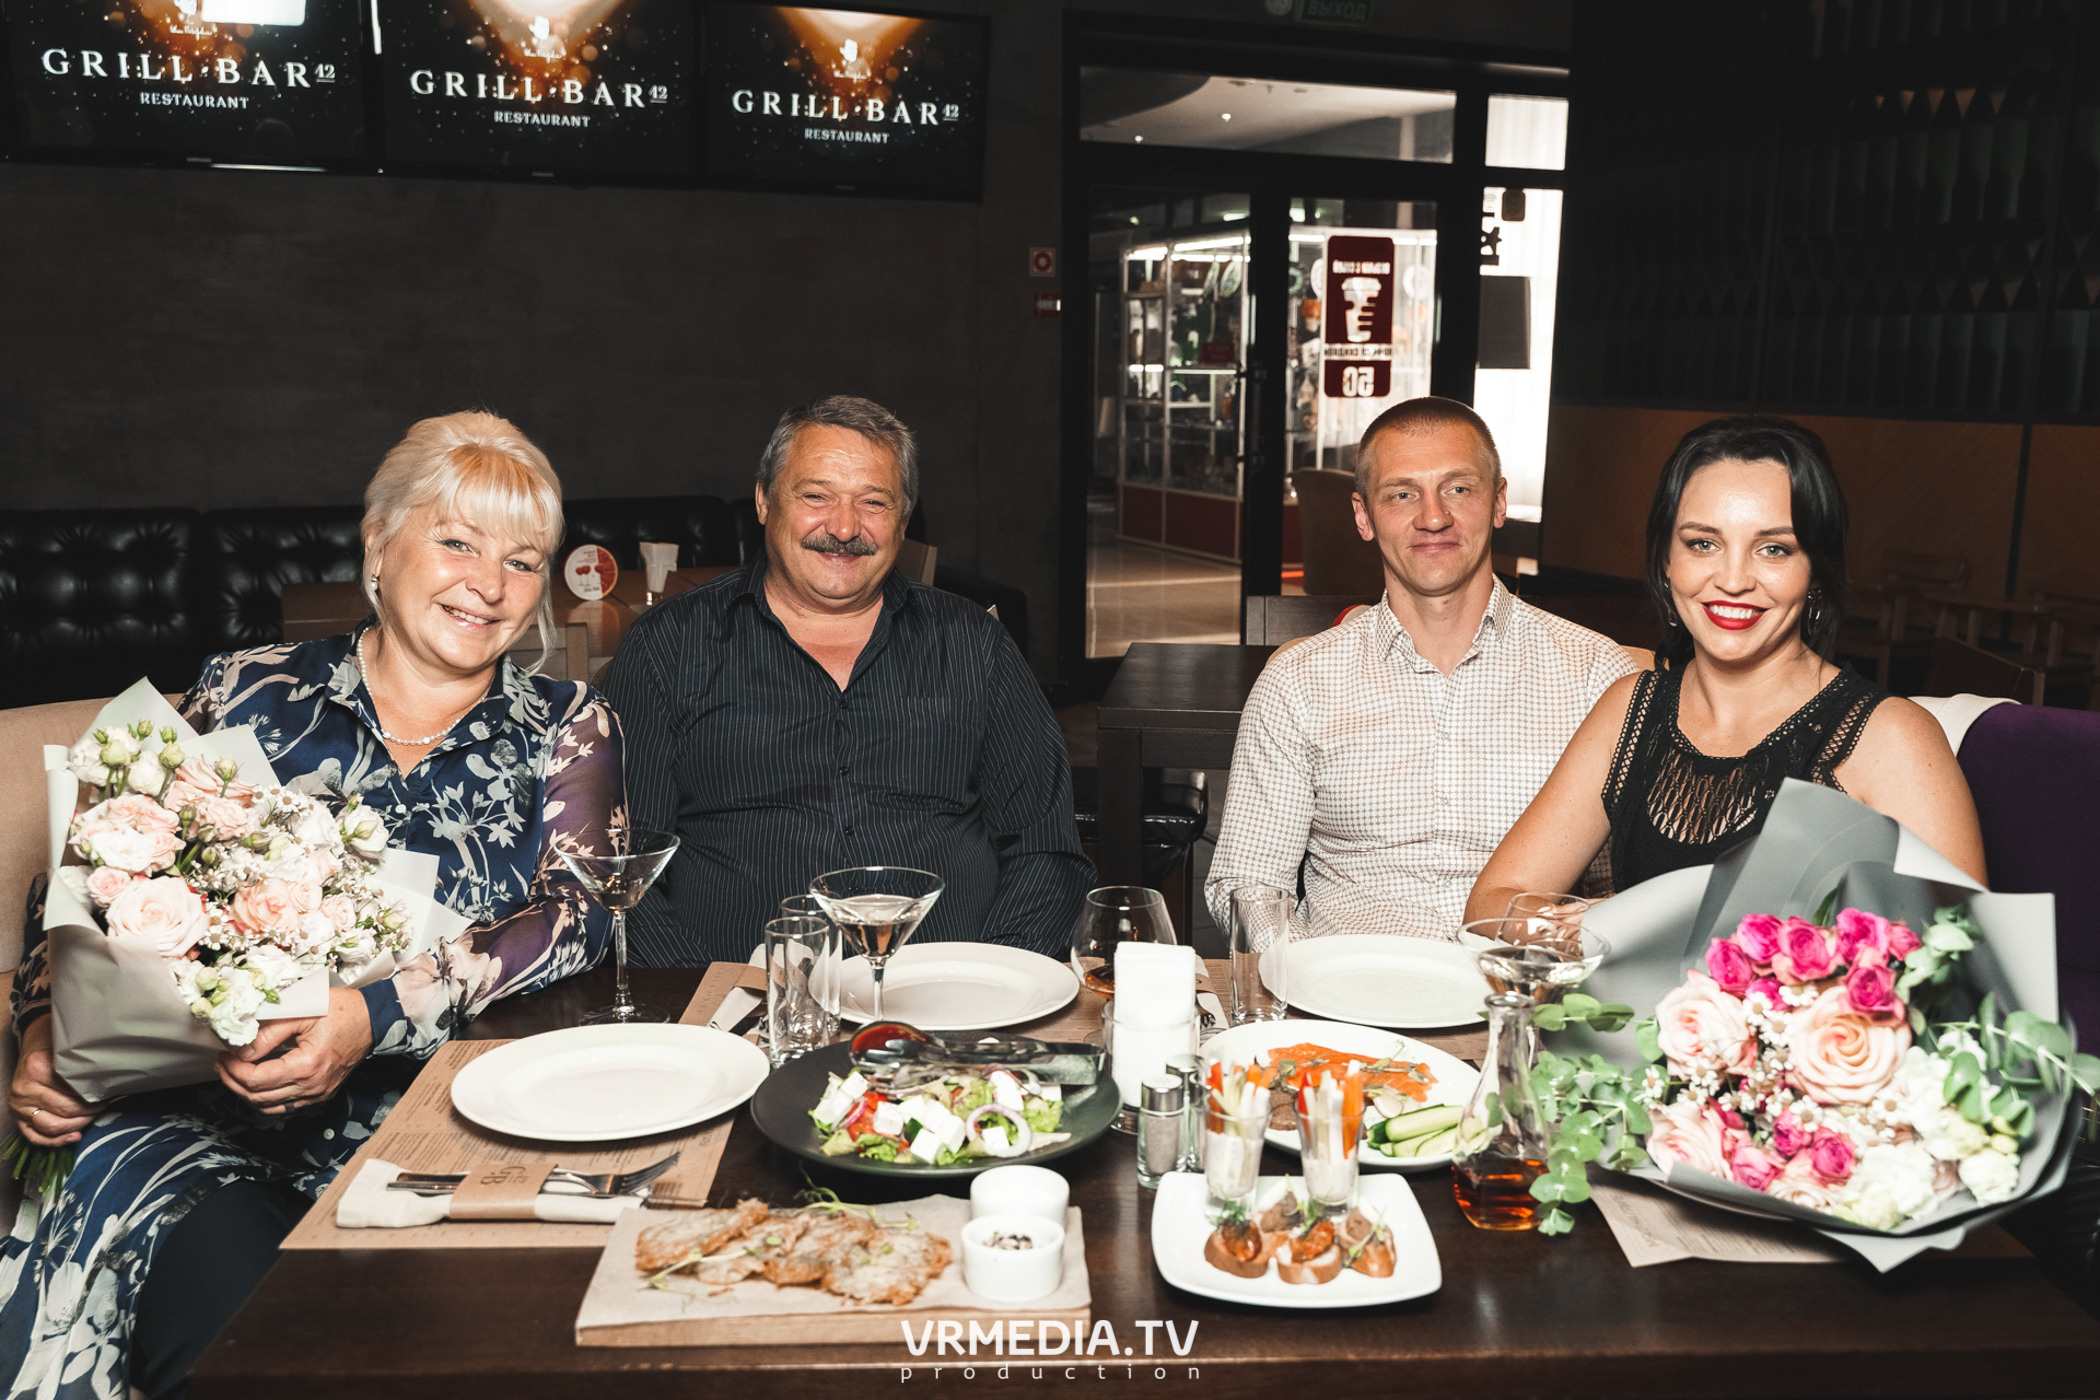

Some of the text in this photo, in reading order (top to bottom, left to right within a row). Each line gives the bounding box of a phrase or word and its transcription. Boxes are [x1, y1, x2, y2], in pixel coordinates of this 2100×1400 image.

[1307, 0, 1367, 22] ВЫХОД
[140, 92, 249, 109] RESTAURANT
[494, 110, 591, 127] RESTAURANT
[804, 128, 889, 144] RESTAURANT
